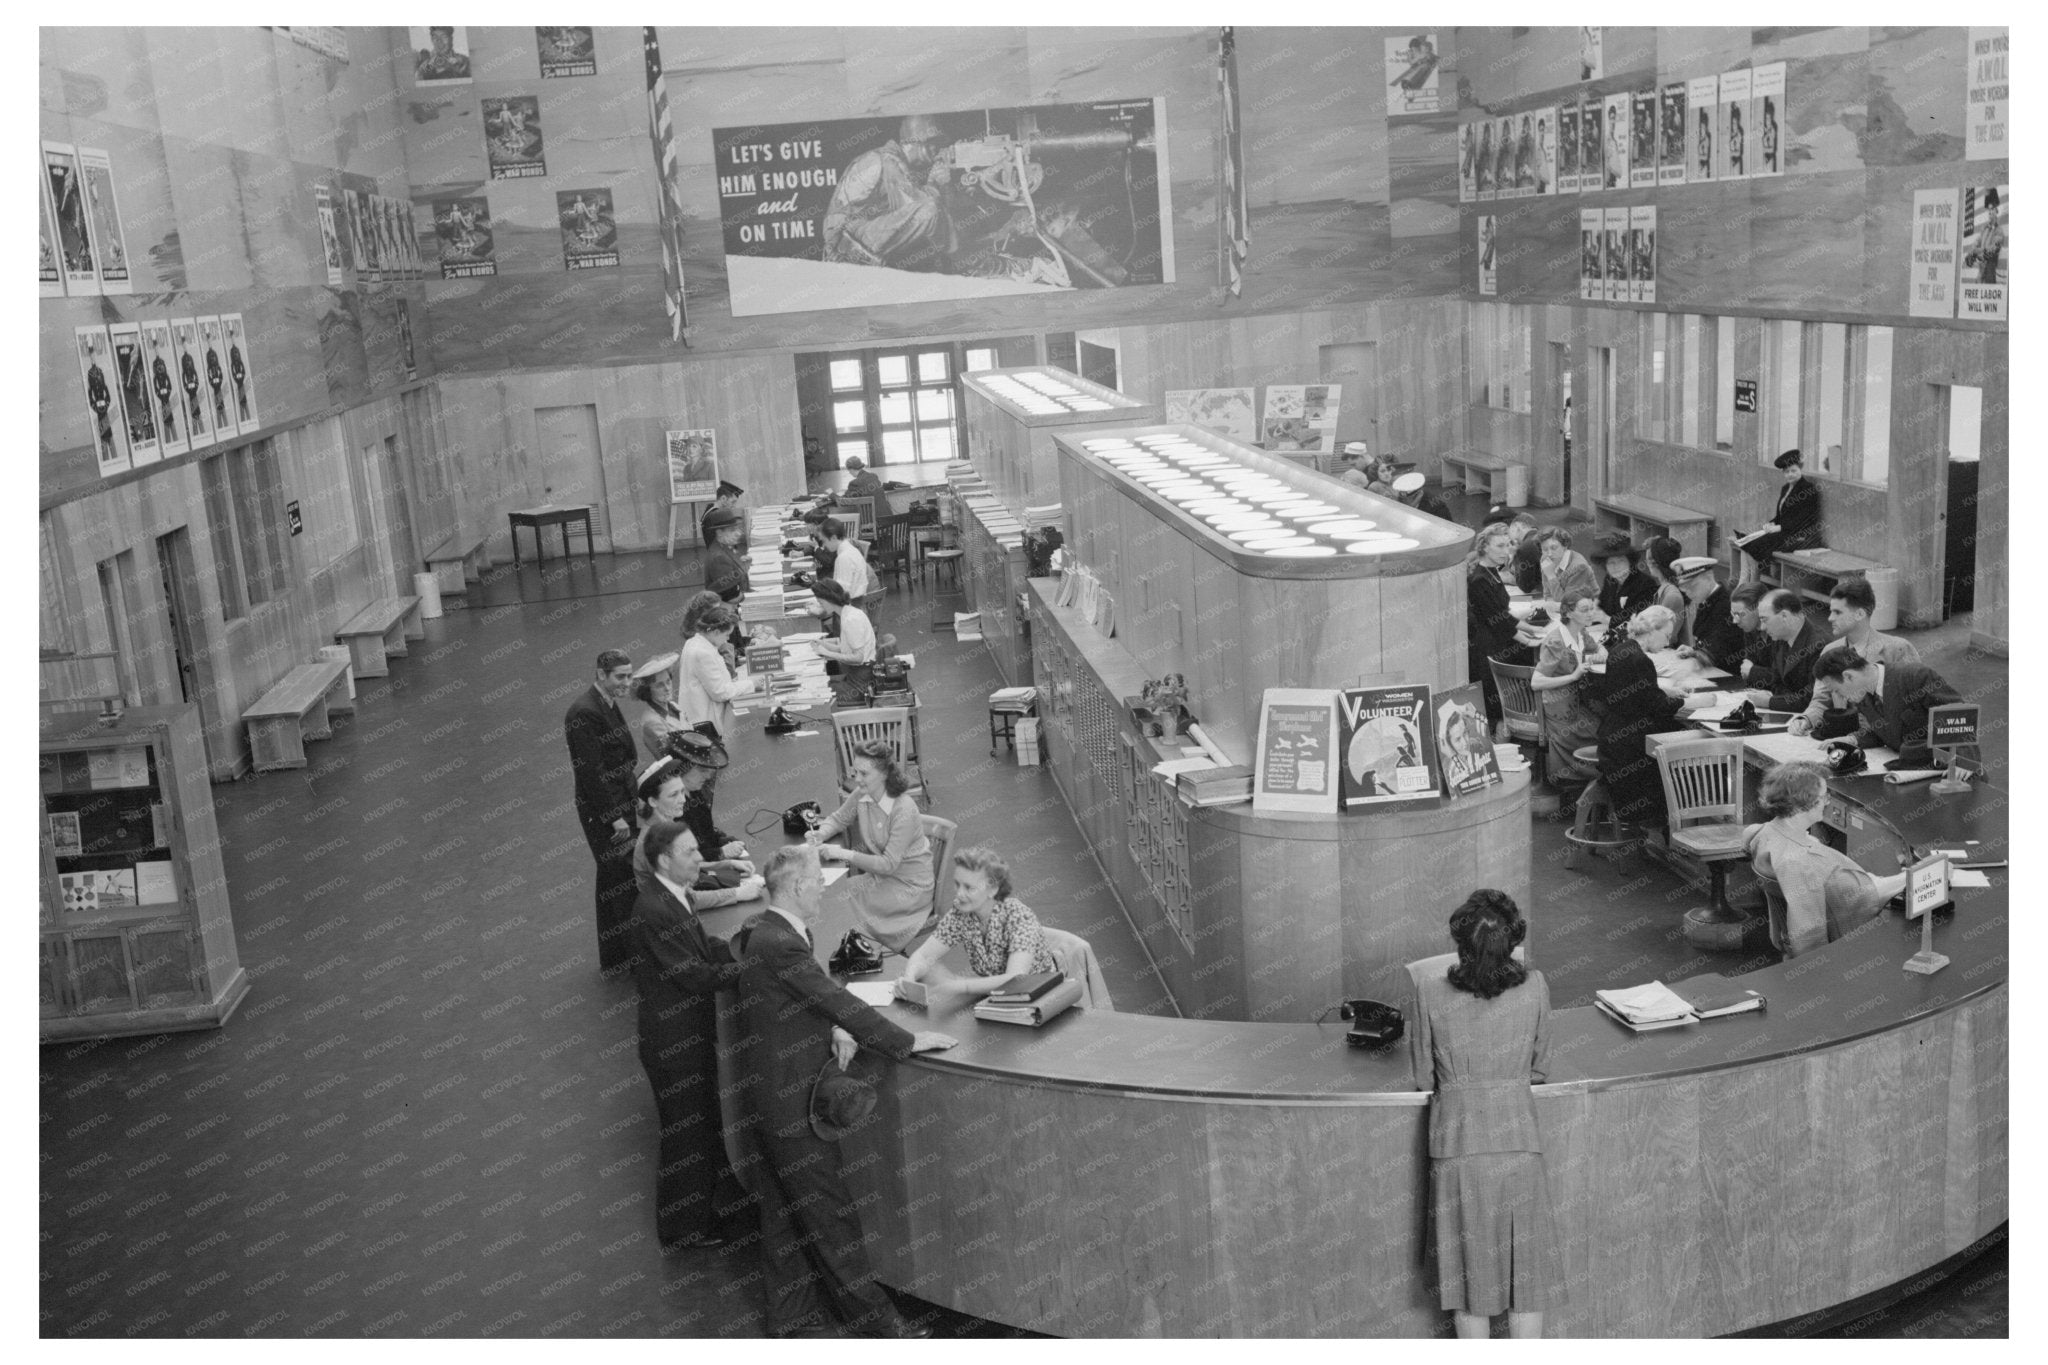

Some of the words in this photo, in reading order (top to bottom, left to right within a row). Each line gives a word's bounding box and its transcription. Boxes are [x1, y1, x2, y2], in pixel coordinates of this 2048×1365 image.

[1975, 39, 1990, 55] WHEN
[555, 67, 570, 76] WAR
[571, 66, 594, 75] BONDS
[1985, 105, 1996, 120] FOR
[1975, 125, 1988, 144] THE
[1988, 123, 2004, 141] AXIS
[731, 143, 774, 165] LET'S
[779, 139, 822, 161] GIVE
[505, 168, 520, 178] WAR
[521, 167, 544, 176] BONDS
[720, 175, 756, 195] HIM
[763, 168, 838, 190] ENOUGH
[758, 193, 798, 216] and
[1920, 204, 1934, 218] WHEN
[740, 223, 766, 244] ON
[773, 220, 815, 241] TIME
[579, 259, 594, 268] WAR
[595, 257, 618, 266] BONDS
[1930, 249, 1953, 264] WORKING
[456, 268, 471, 277] WAR
[472, 266, 494, 276] BONDS
[1928, 267, 1938, 281] FOR
[1918, 284, 1930, 300] THE
[1931, 284, 1946, 301] AXIS
[1964, 288, 1979, 300] FREE
[1981, 288, 2002, 300] LABOR
[1968, 302, 1982, 312] WILL
[1984, 303, 1998, 312] WIN
[1946, 717, 1967, 725] WAR
[1937, 726, 1974, 734] HOUSING
[1917, 890, 1936, 903] CENTER
